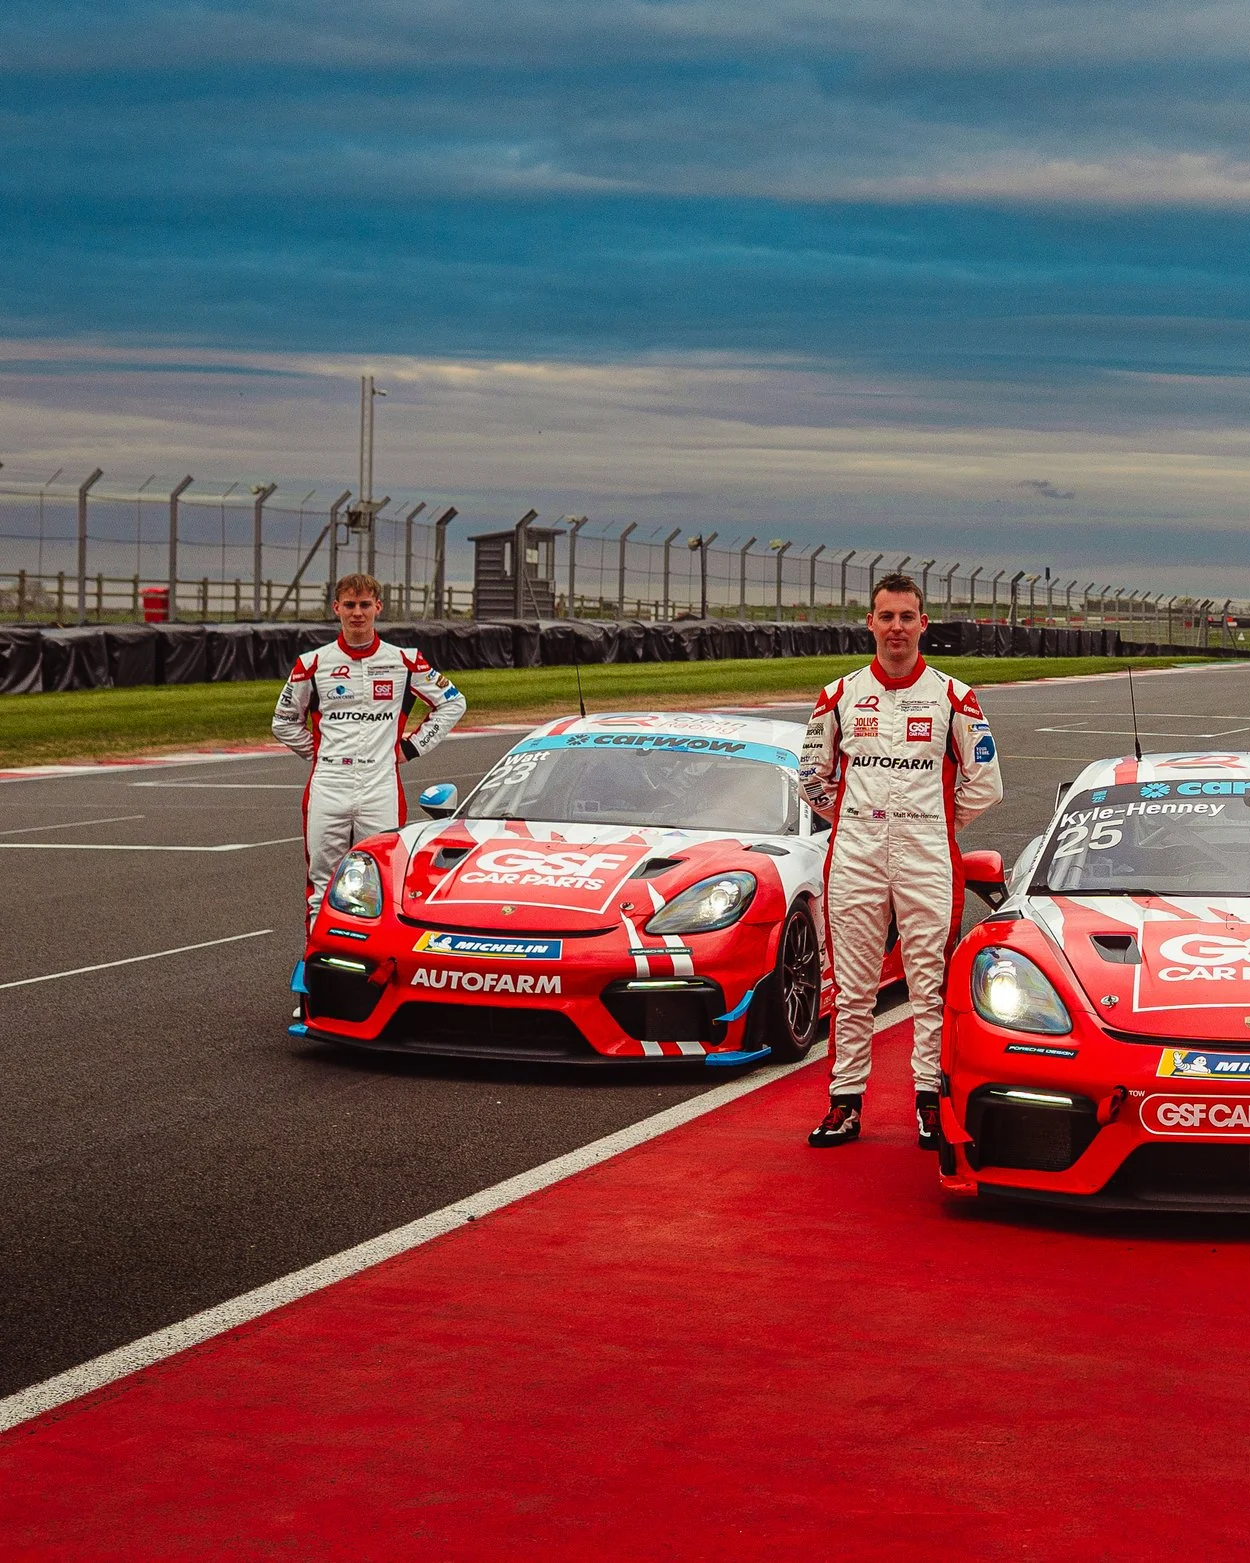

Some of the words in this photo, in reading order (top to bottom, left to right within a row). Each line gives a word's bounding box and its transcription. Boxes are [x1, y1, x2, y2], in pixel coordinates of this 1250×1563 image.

[329, 712, 393, 721] AUTOFARM
[674, 716, 748, 728] Clean
[909, 722, 931, 732] GSF
[593, 735, 746, 753] carwow
[505, 751, 551, 766] Watt
[852, 756, 934, 770] AUTOFARM
[480, 761, 537, 791] 23
[1060, 801, 1226, 828] Kyle-Henney
[1053, 819, 1125, 860] 25
[475, 848, 629, 878] GSF
[460, 871, 517, 884] CAR
[516, 874, 605, 890] PARTS
[454, 940, 549, 954] MICHELIN
[410, 968, 562, 994] AUTOFARM
[1158, 966, 1237, 982] CAR
[1008, 1045, 1045, 1053] PORSCHE
[1045, 1048, 1075, 1057] DESIGN
[1157, 1102, 1207, 1127] GSF
